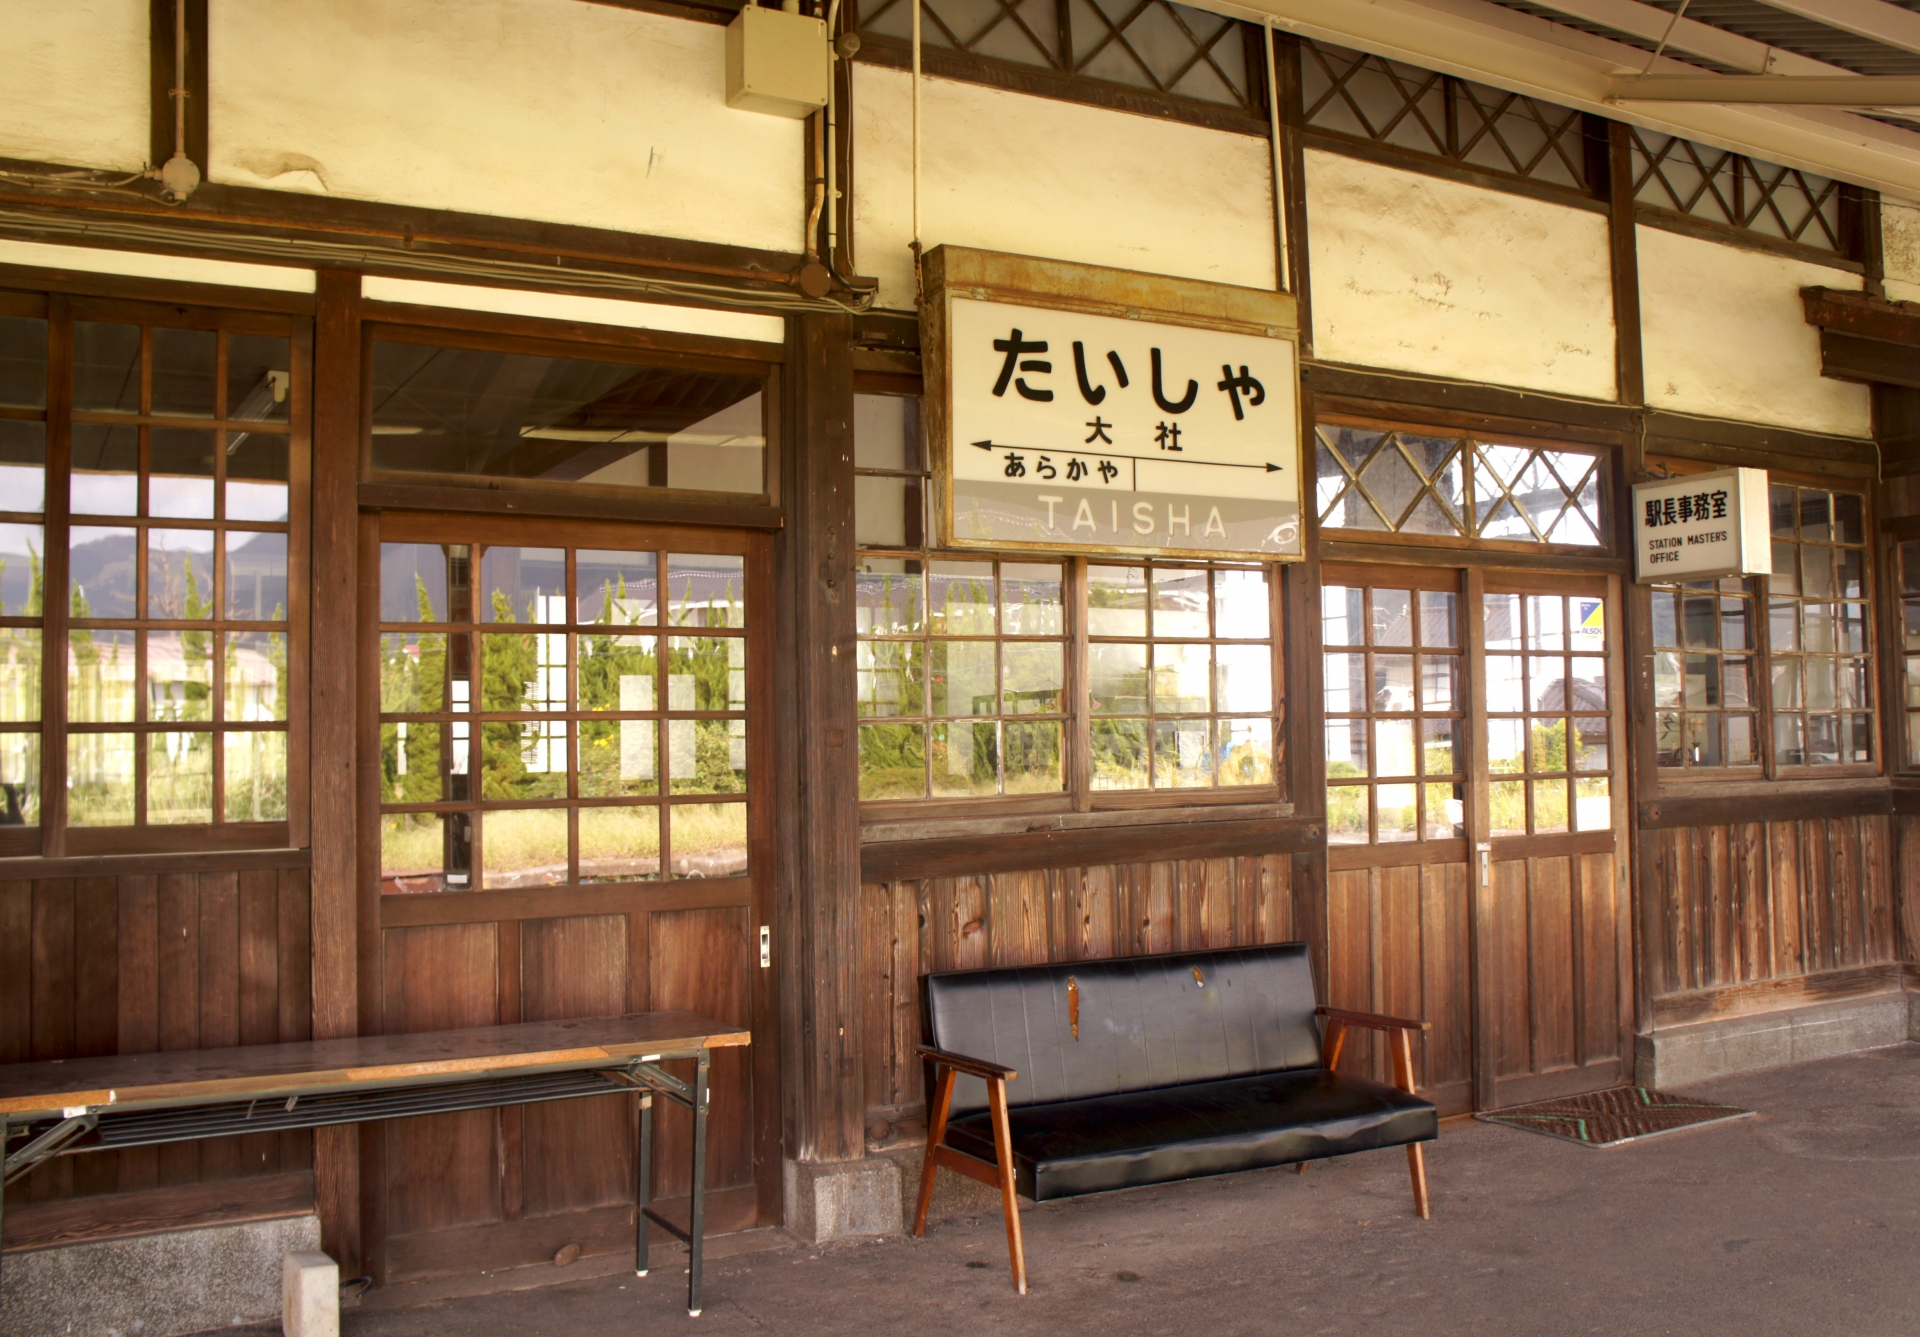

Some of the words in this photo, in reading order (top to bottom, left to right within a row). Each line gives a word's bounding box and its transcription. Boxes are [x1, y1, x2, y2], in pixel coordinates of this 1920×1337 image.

[1085, 416, 1183, 451] 大社
[1003, 452, 1119, 484] あらかや
[1038, 495, 1229, 539] TAISHA
[1645, 490, 1727, 527] 駅長事務室
[1649, 537, 1682, 550] STATION
[1650, 551, 1680, 564] OFFICE
